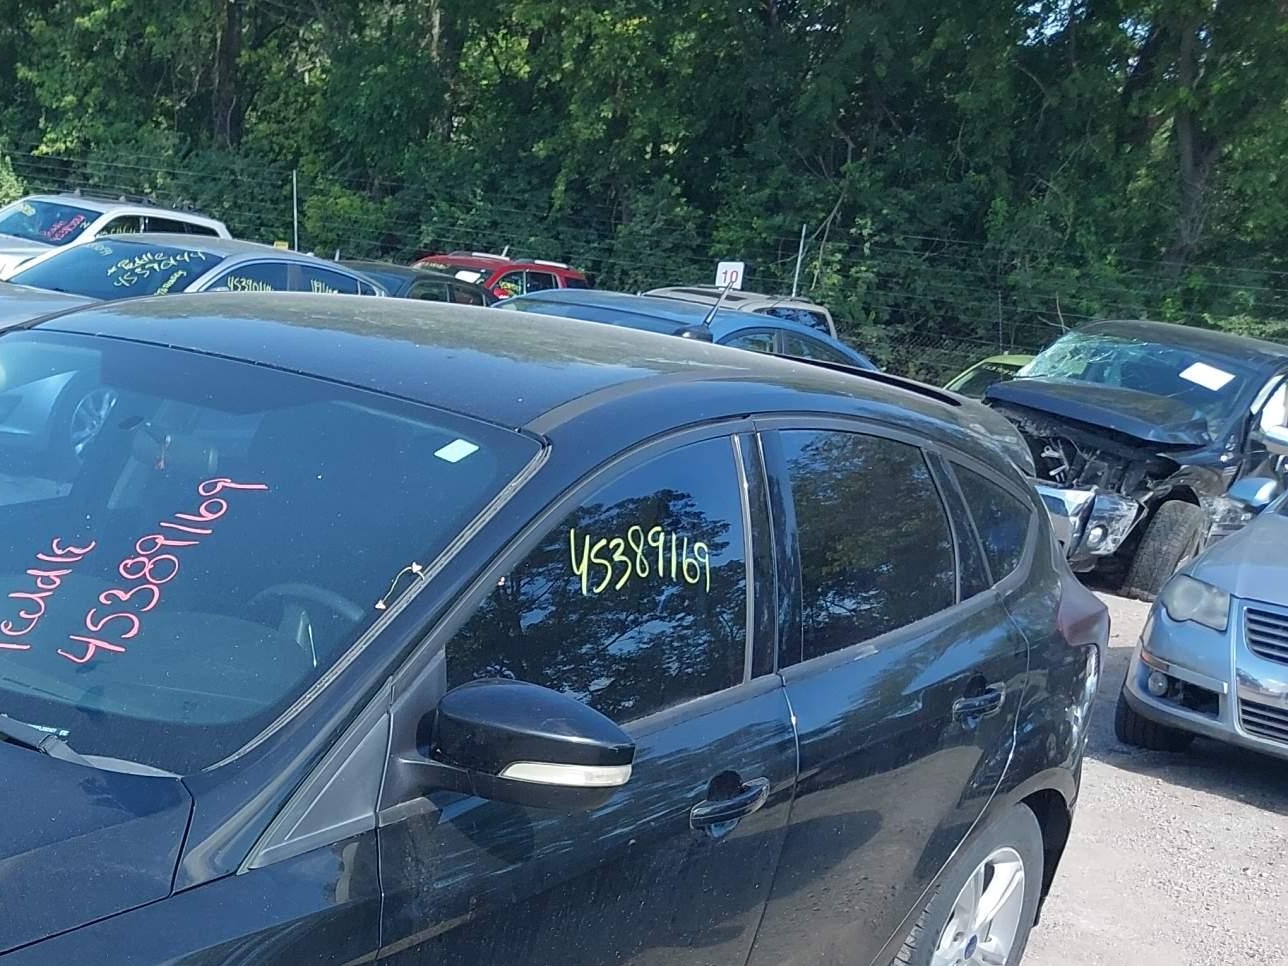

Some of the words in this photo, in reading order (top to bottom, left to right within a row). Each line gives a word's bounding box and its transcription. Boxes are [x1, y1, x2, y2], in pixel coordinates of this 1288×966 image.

[721, 269, 739, 284] 10
[57, 478, 269, 663] 45389169
[569, 525, 710, 596] 45389169
